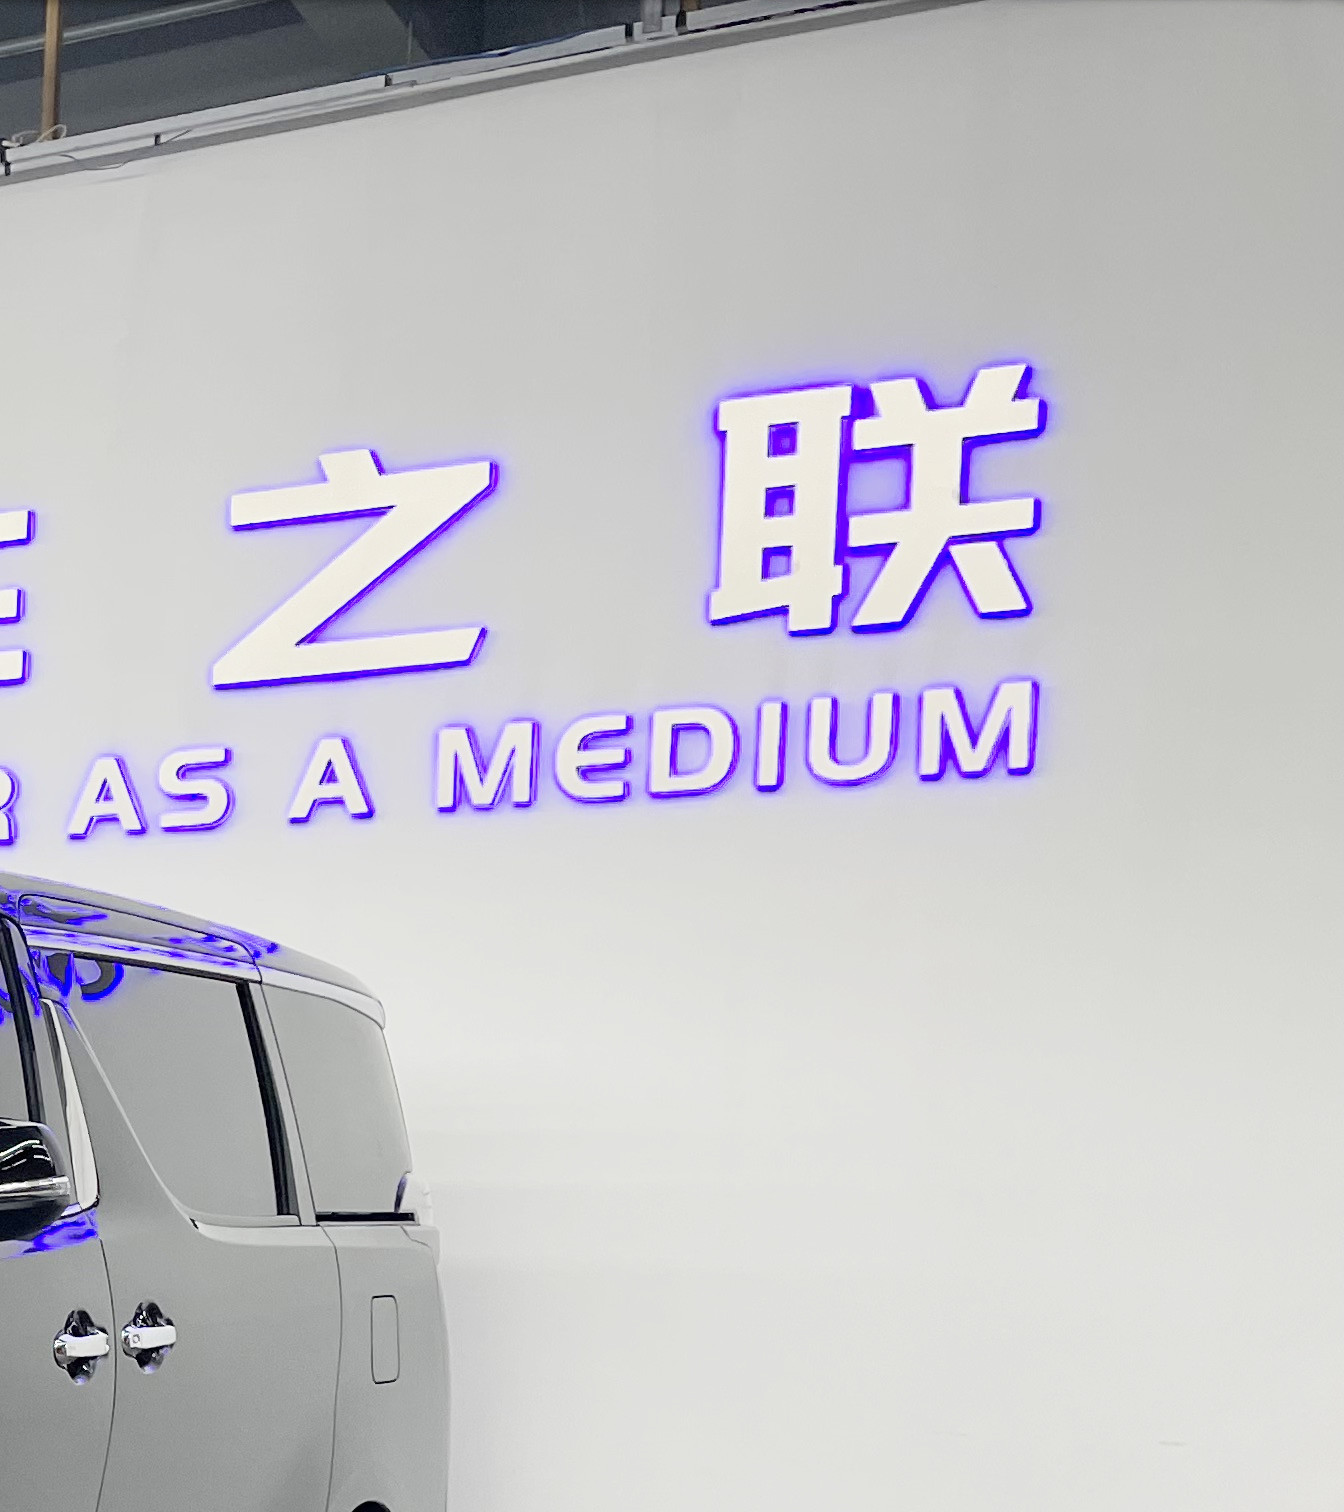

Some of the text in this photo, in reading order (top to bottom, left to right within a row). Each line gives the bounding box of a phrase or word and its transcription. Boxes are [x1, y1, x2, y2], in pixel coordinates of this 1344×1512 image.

[68, 747, 232, 841] AS
[288, 736, 375, 825] A
[436, 680, 1040, 813] MEDIUM
